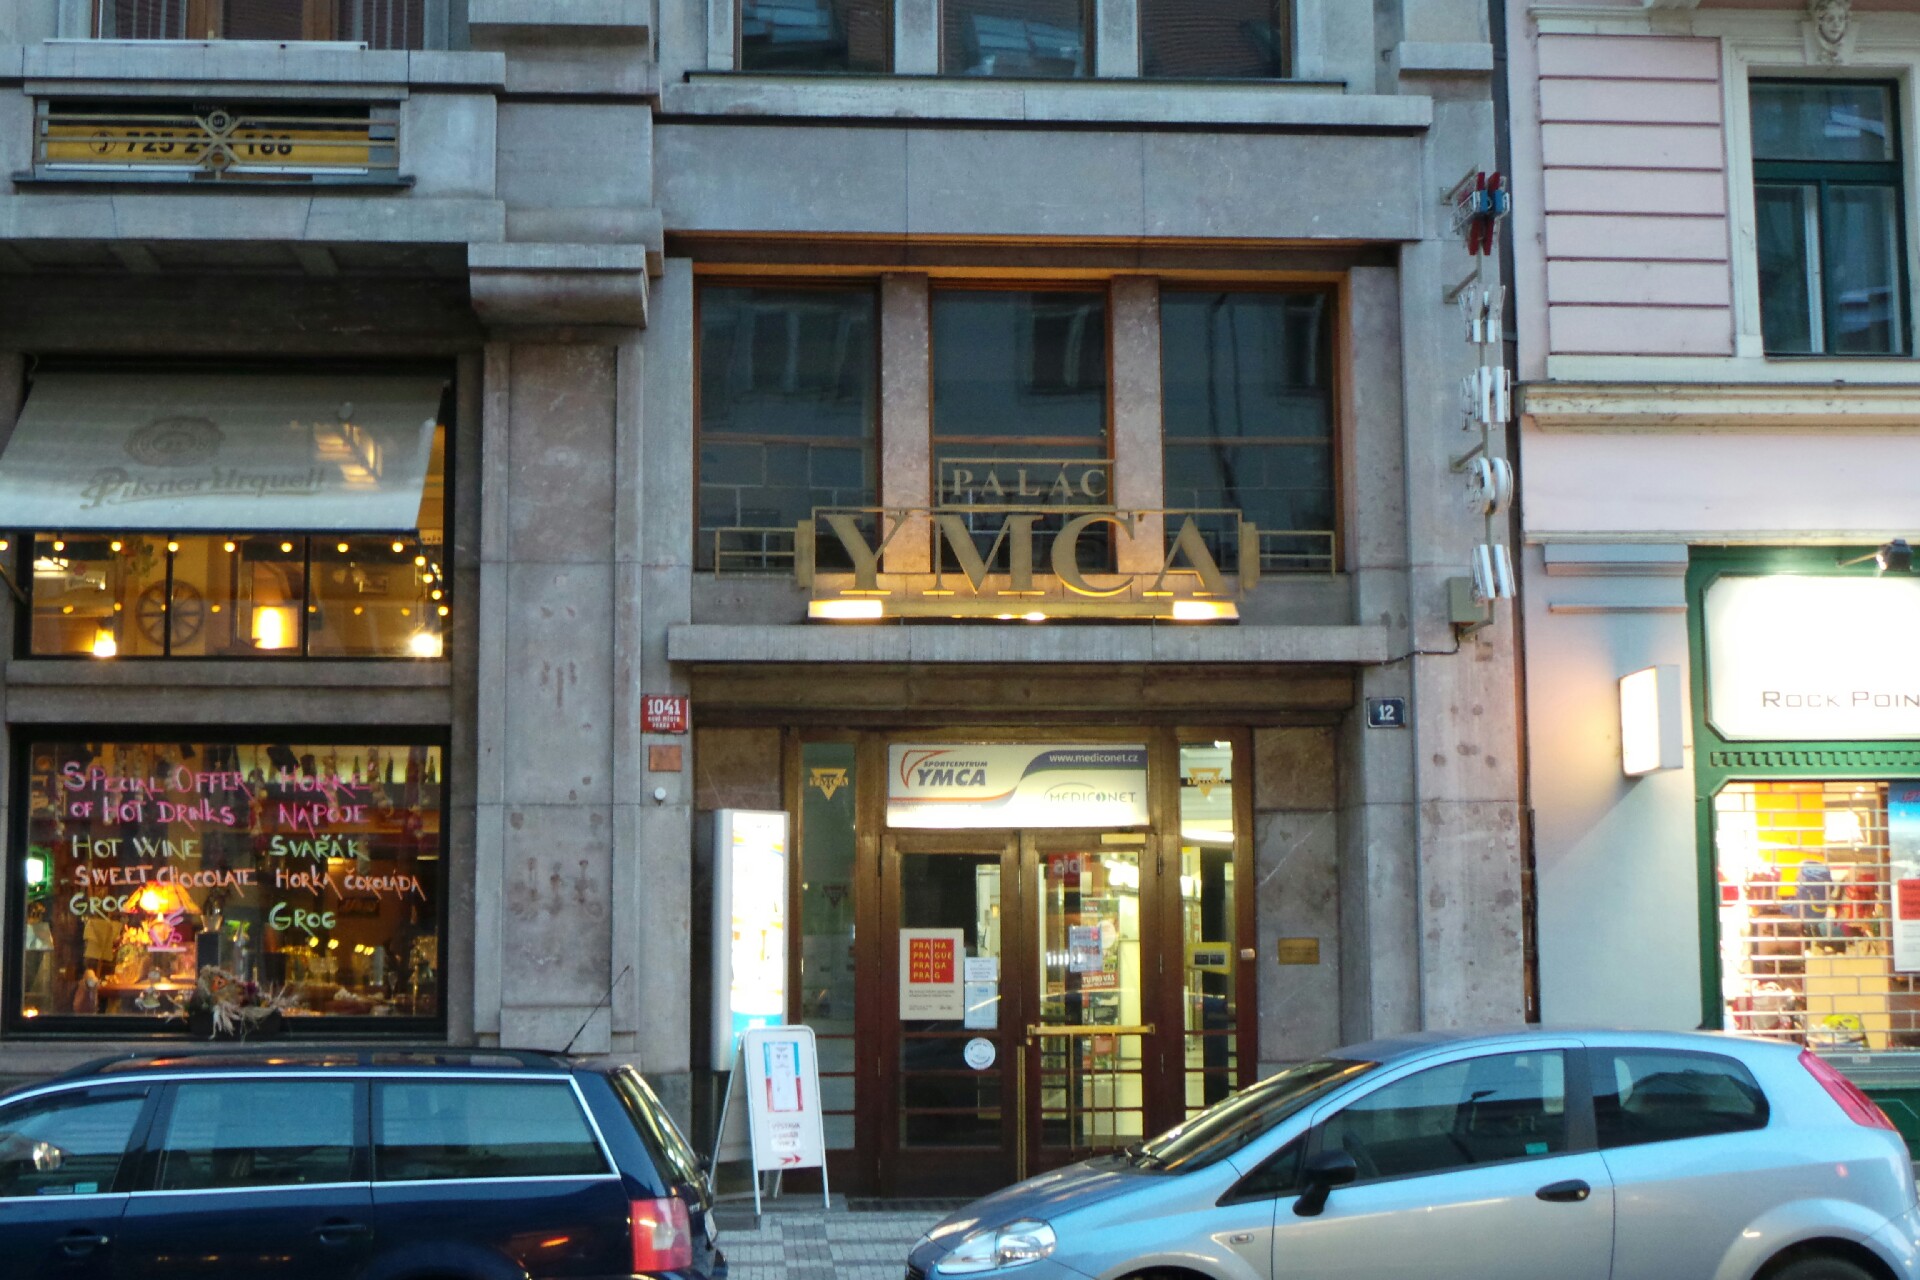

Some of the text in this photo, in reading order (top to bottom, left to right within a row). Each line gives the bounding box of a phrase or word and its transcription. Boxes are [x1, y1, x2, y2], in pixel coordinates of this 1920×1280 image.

[79, 466, 325, 509] Pilsner Urquell
[953, 462, 1106, 498] PALÁC
[822, 512, 1230, 597] YMCA
[647, 698, 681, 716] 1041
[1379, 704, 1395, 721] 12
[1050, 753, 1139, 763] www.mediconet.cz
[917, 768, 986, 787] YMCA
[103, 796, 147, 824] HOT
[72, 834, 202, 861] HOT WINE
[269, 834, 371, 864] SVAŘÁK
[74, 864, 258, 898] SWEET CHOCOLATE
[344, 868, 426, 901] ČOKOLÁDA
[269, 902, 336, 937] GROG
